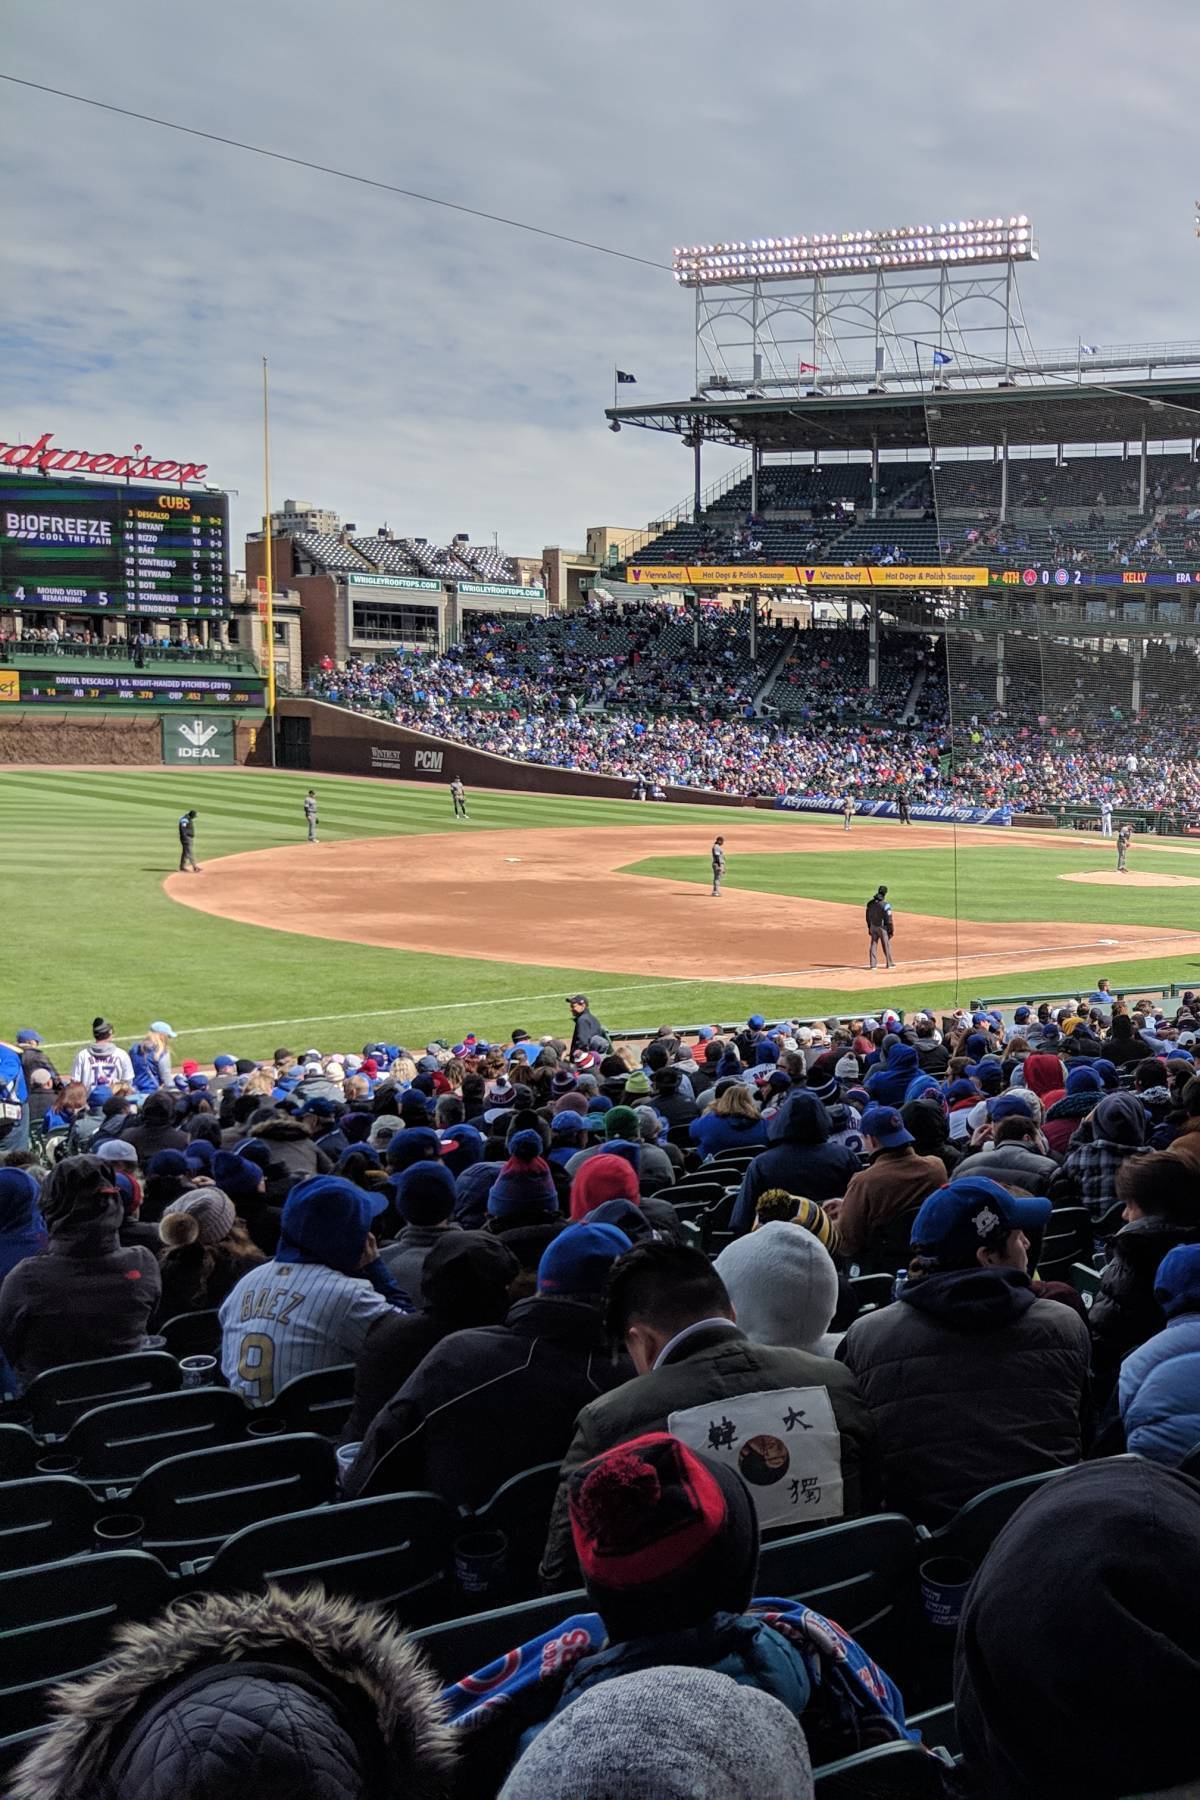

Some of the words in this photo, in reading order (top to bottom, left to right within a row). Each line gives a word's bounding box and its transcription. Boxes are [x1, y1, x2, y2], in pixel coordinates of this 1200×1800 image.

[158, 495, 191, 510] CUBS
[137, 510, 170, 520] DESCALSO
[137, 522, 164, 531] BRYANT
[40, 533, 64, 542] COOL
[68, 534, 86, 543] THE
[90, 536, 112, 545] PAIN
[138, 534, 158, 542] RIZZO
[138, 545, 155, 554] BÁEZ
[138, 558, 177, 568] CONTRERAS
[138, 570, 172, 579] HEYWARD
[703, 571, 714, 579] Hot
[715, 571, 731, 580] Dogs
[739, 571, 758, 579] Polish
[759, 572, 785, 580] Sausage
[886, 572, 898, 580] Hot
[900, 572, 917, 582] Dogs
[925, 572, 946, 581] Polish
[947, 573, 976, 582] Sausage
[1002, 571, 1020, 584] 4TH
[1042, 571, 1050, 585] 0
[1074, 571, 1082, 585] 2
[1122, 571, 1147, 584] KELLY
[1176, 573, 1191, 583] ERA
[139, 581, 156, 590] BOTE
[15, 586, 26, 601] 4
[37, 586, 65, 595] MOUND
[66, 588, 87, 597] VISITS
[42, 594, 83, 604] REMAINING
[99, 591, 109, 606] 5
[139, 593, 180, 603] SCHWARBER
[139, 604, 177, 614] HENDRICKS
[56, 676, 80, 685] DANIEL
[82, 677, 114, 686] DESCALSO
[132, 680, 181, 688] RIGHT-HANDED
[181, 681, 210, 689] PITCHERS
[74, 689, 85, 697] AB
[119, 690, 134, 699] AVG
[178, 747, 220, 758] IDEAL
[414, 750, 444, 769] PCM
[781, 795, 831, 810] Reynolds
[240, 1287, 306, 1326] BAEZ
[237, 1331, 276, 1408] 9
